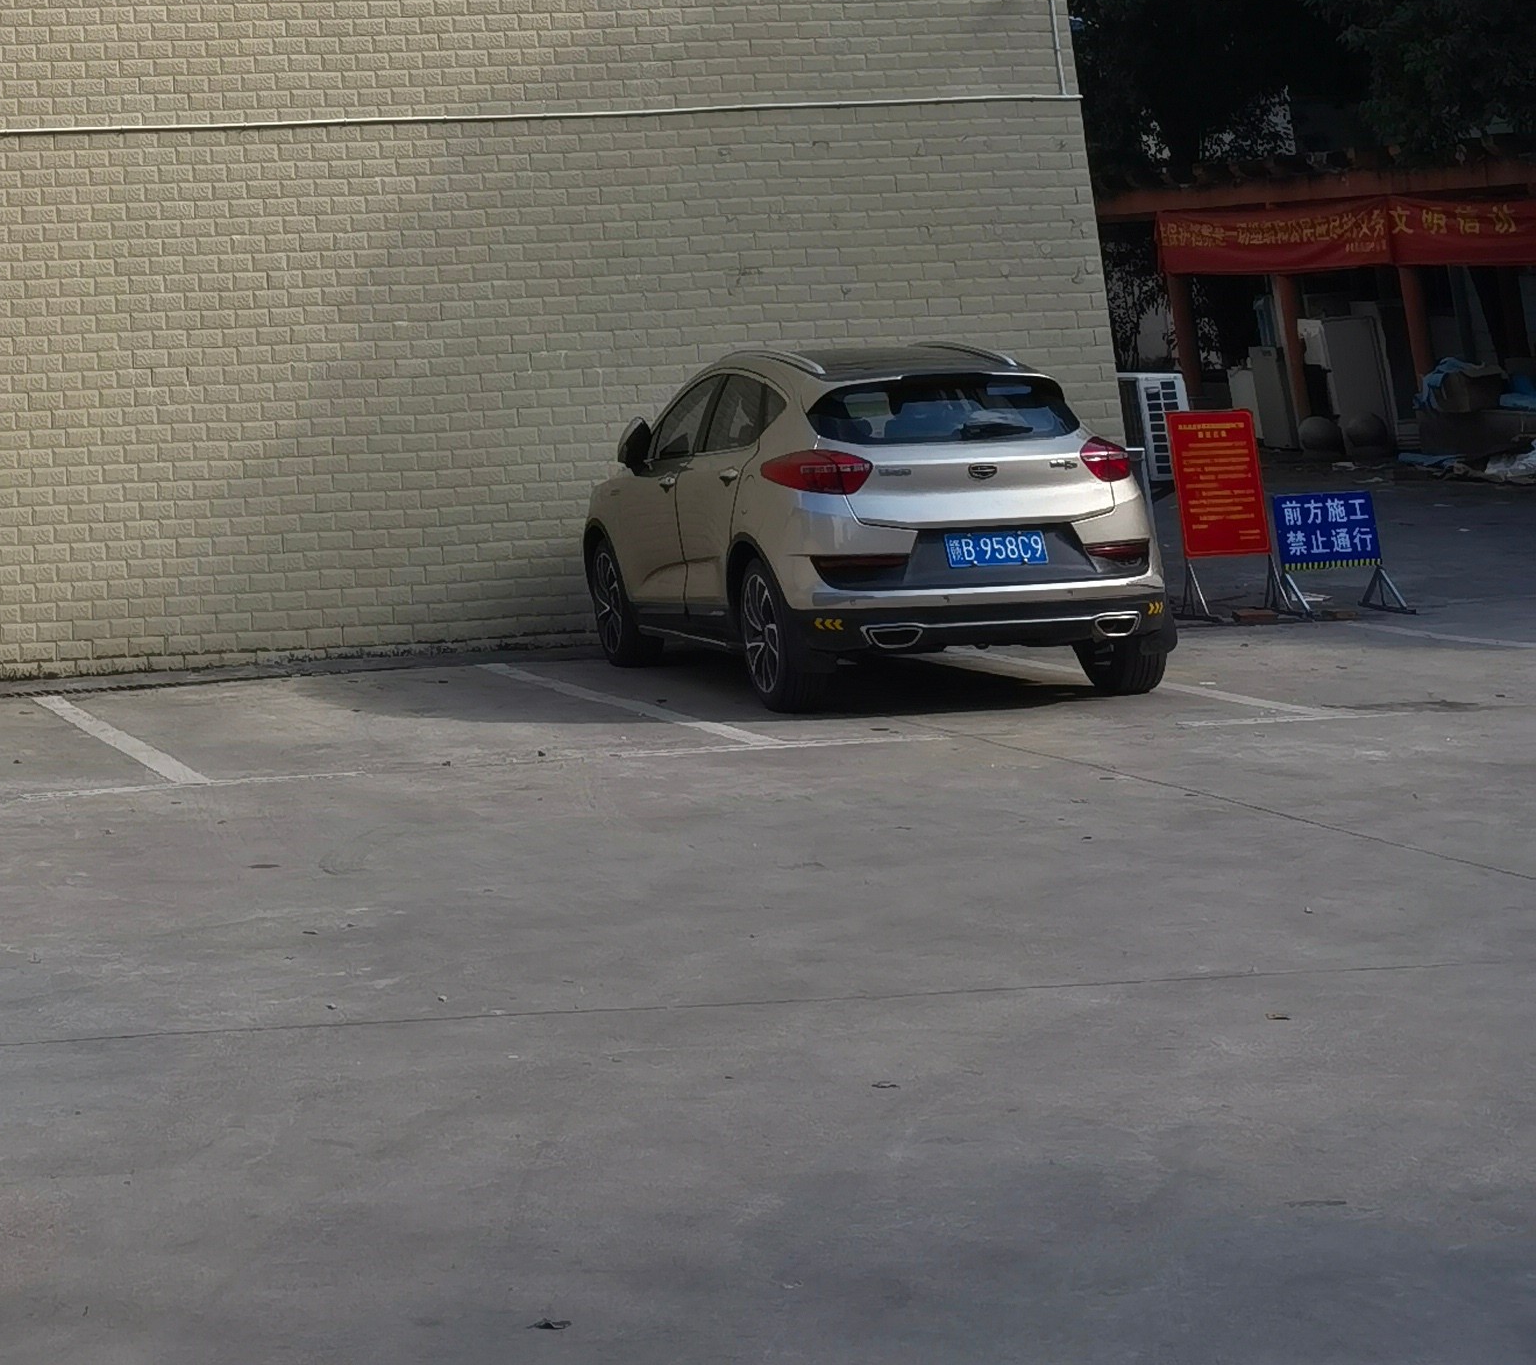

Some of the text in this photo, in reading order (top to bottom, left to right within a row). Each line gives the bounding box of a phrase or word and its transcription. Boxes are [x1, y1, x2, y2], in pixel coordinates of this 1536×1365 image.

[1281, 498, 1369, 525] 前方施工
[1286, 527, 1372, 556] 禁止通行
